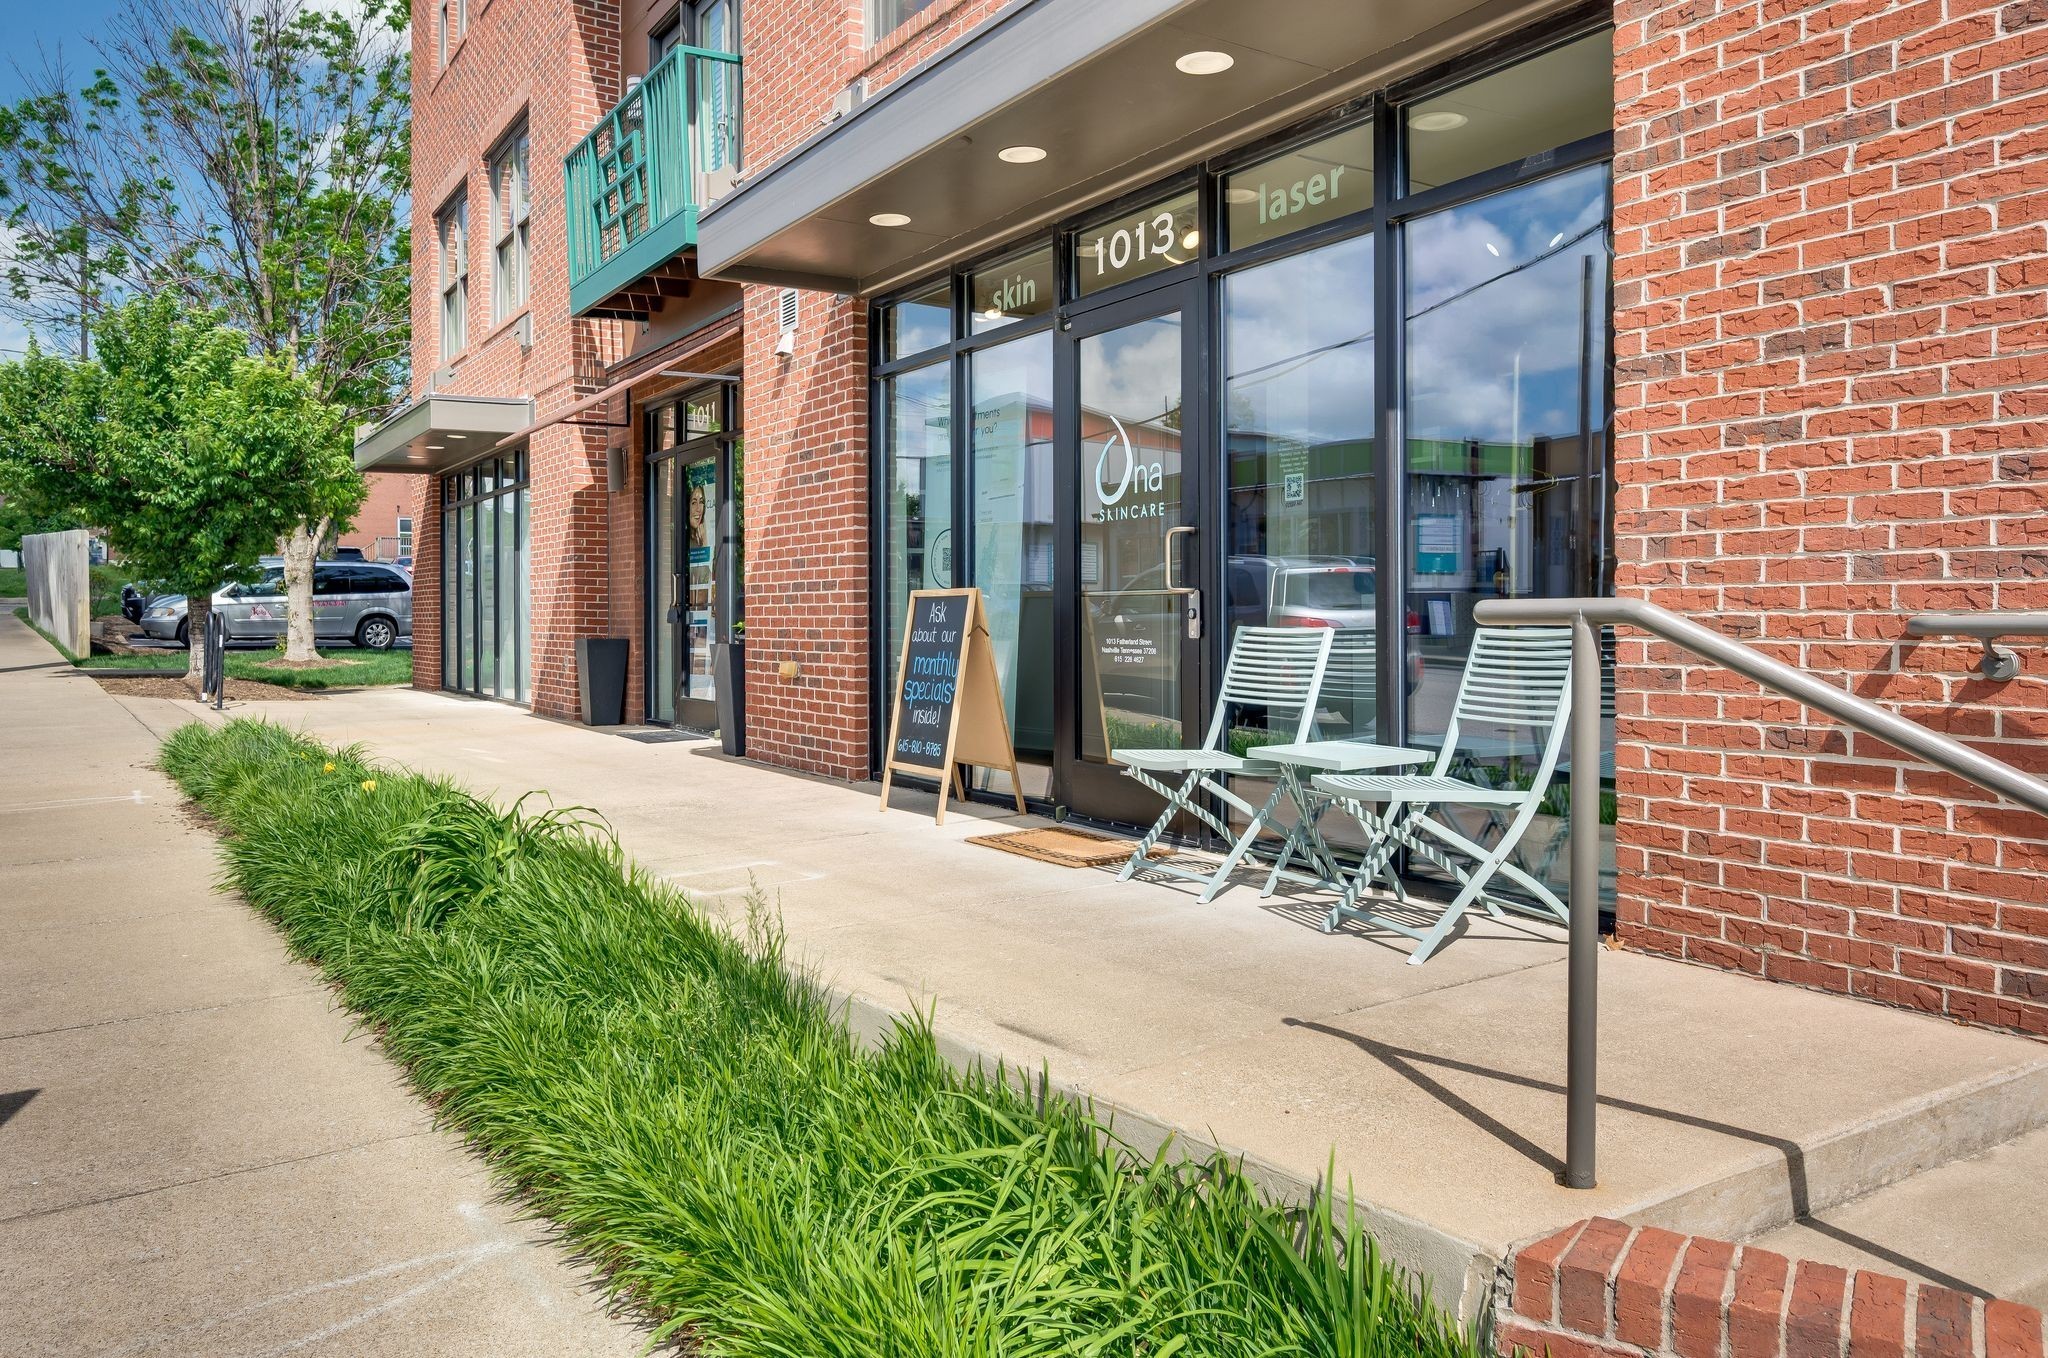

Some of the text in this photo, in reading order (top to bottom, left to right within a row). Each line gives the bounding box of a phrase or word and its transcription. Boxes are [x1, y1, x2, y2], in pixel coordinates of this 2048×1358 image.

[1259, 165, 1344, 224] laser
[1095, 212, 1175, 276] 1013
[993, 275, 1036, 312] skin
[692, 401, 716, 430] 1011
[1100, 502, 1165, 522] SKINCARE
[929, 602, 947, 623] Ask
[912, 627, 957, 643] about our
[1117, 638, 1139, 646] Fatherland
[1139, 638, 1153, 646] Street
[1101, 646, 1120, 654] Nashville
[1120, 646, 1143, 655] Tennessee
[913, 651, 959, 680] monthly
[904, 679, 957, 709] specials
[912, 705, 942, 729] inside!
